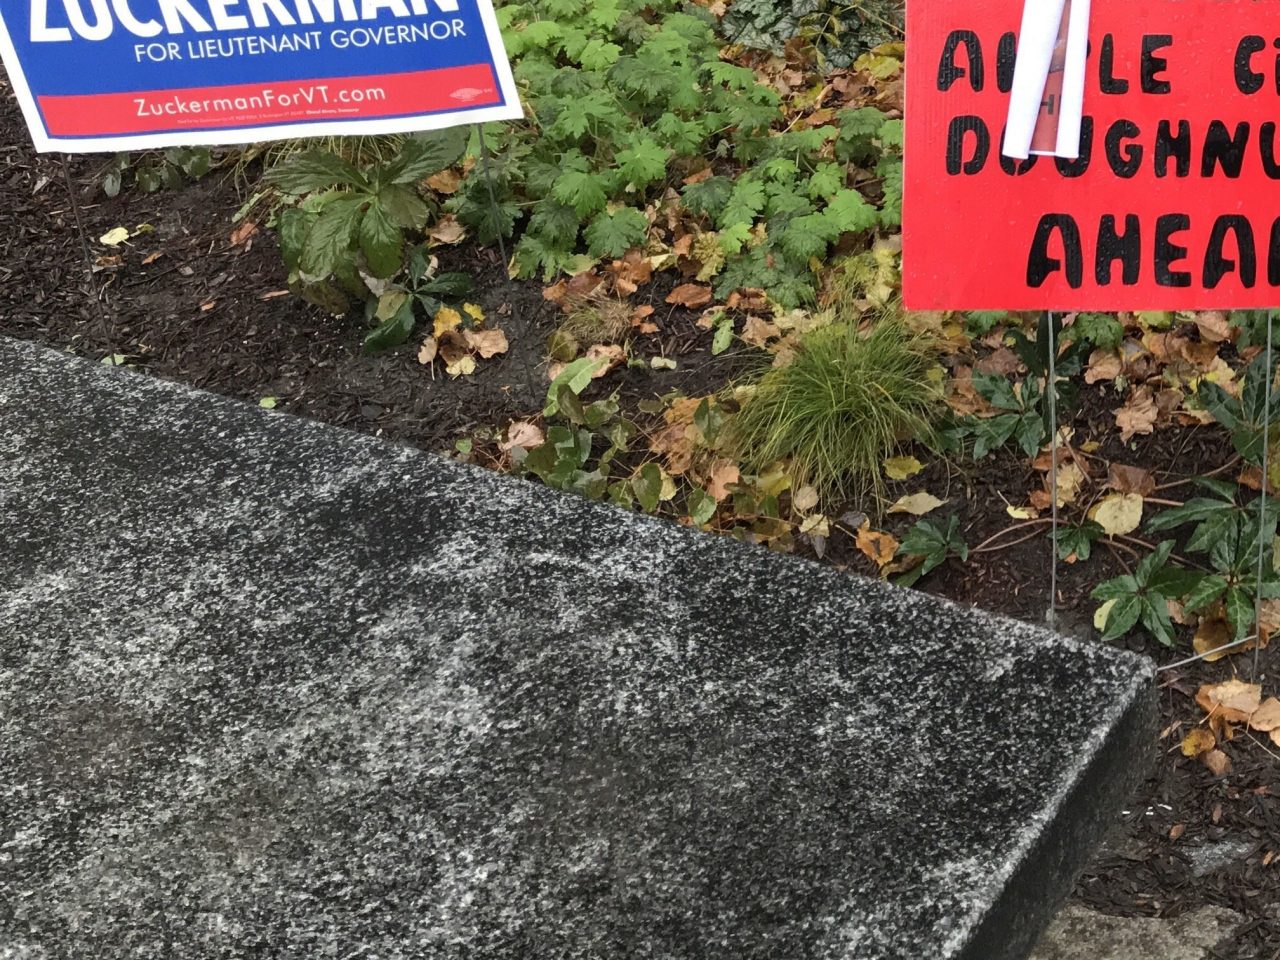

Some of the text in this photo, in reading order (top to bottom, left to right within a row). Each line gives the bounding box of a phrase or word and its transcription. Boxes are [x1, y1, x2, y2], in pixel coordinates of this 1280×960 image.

[134, 19, 466, 63] FOR LIEUTENANT GOVERNOR
[936, 30, 1173, 95] ALE
[134, 84, 386, 117] ZuckermanForVT.com
